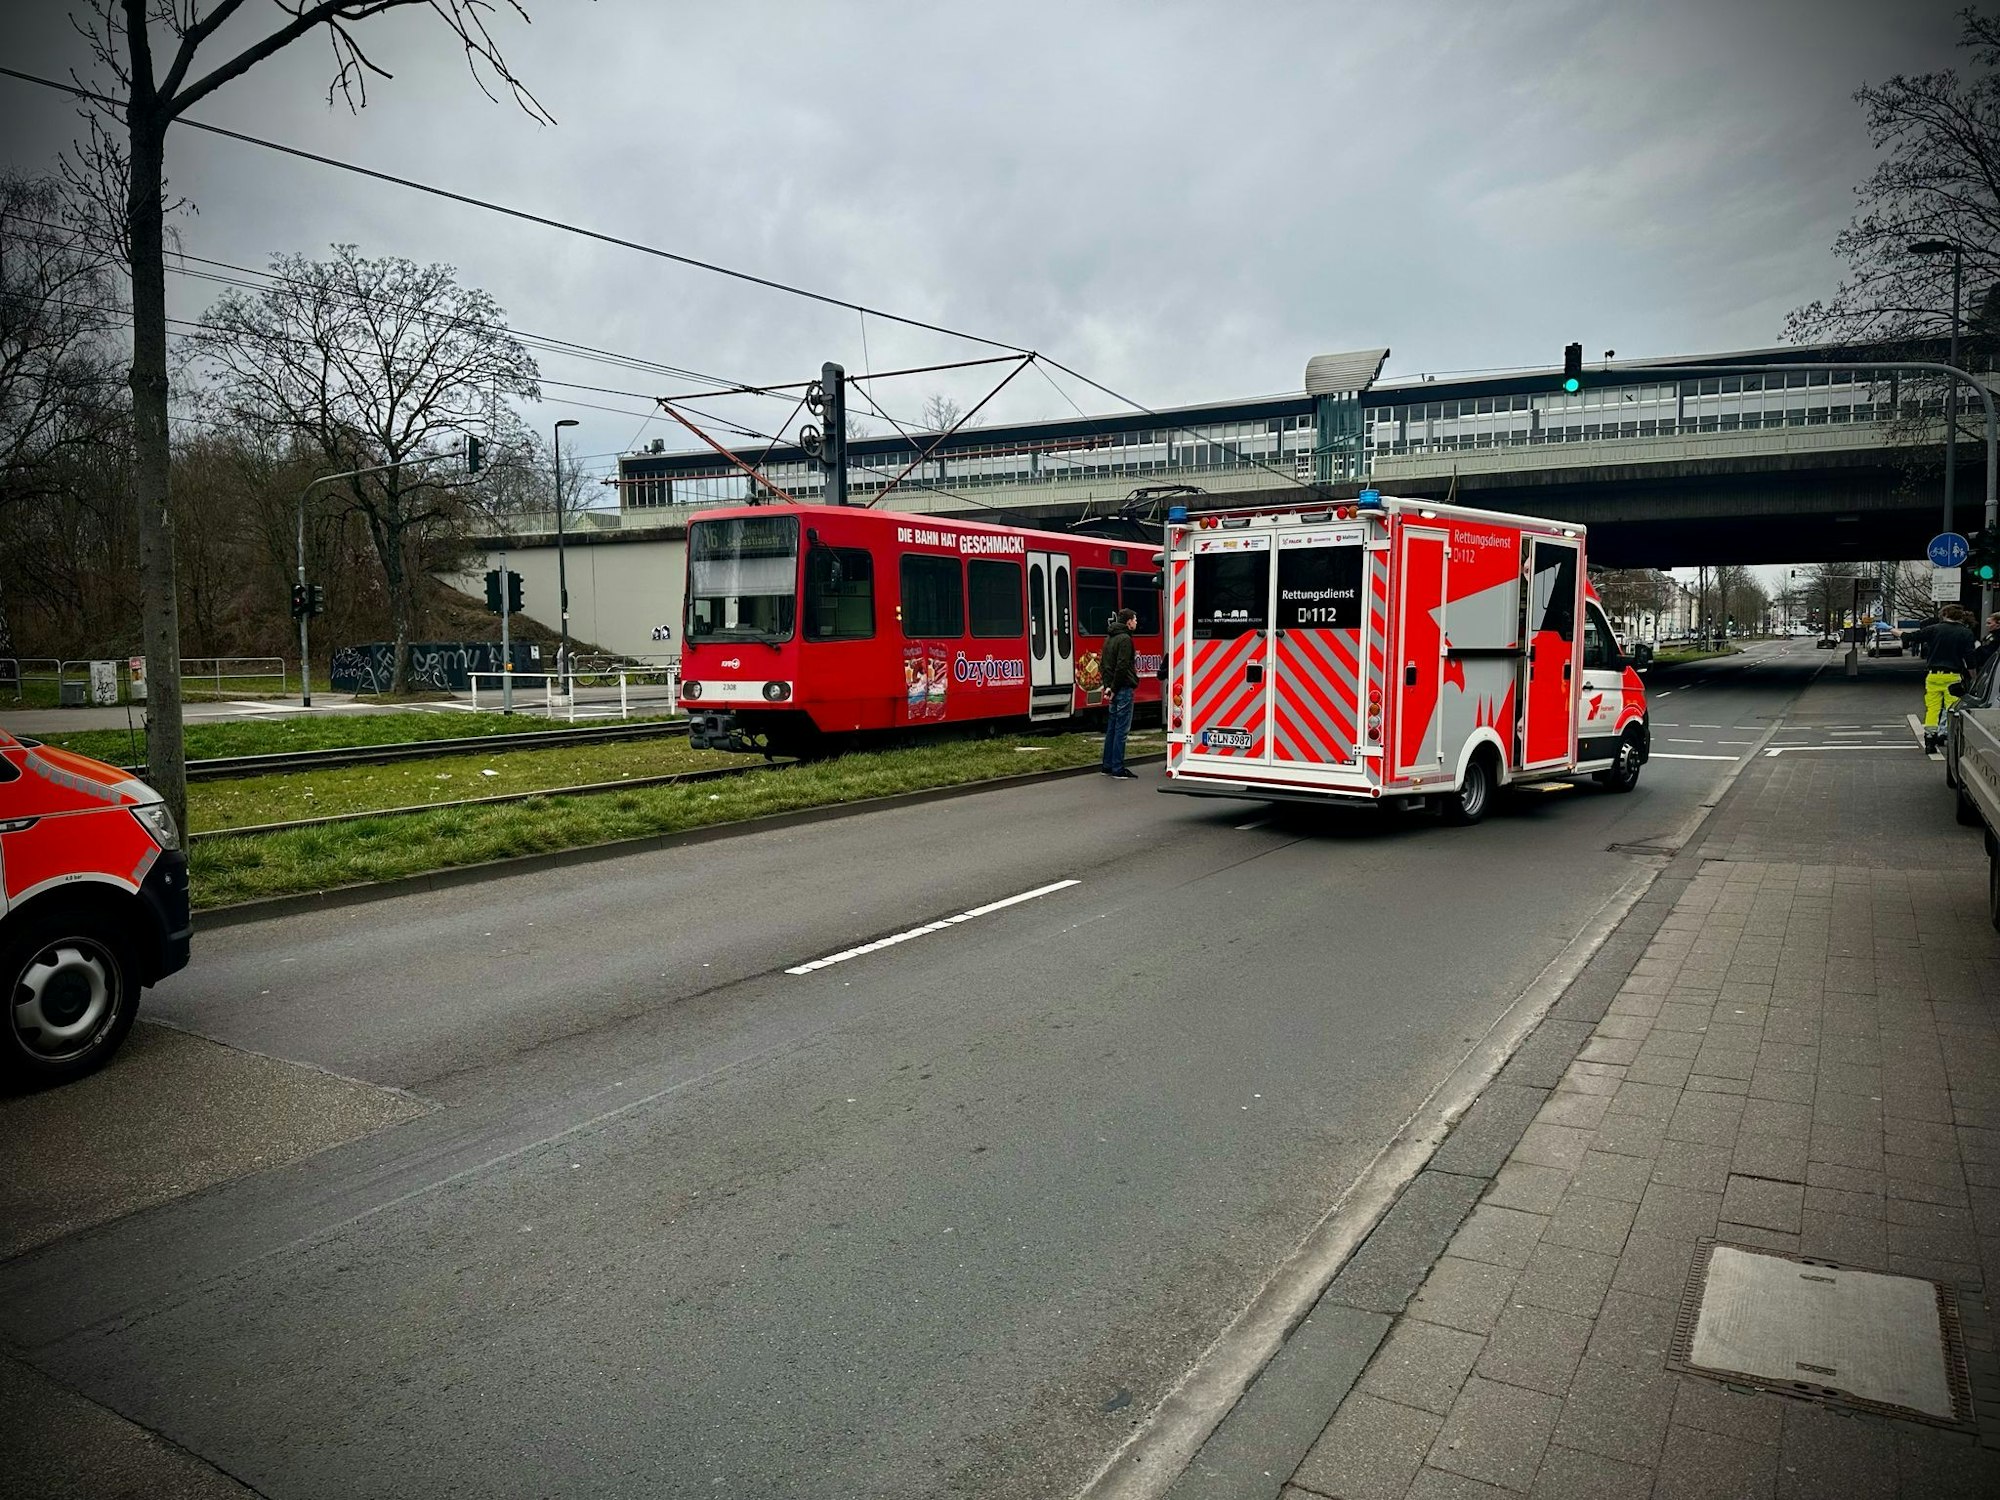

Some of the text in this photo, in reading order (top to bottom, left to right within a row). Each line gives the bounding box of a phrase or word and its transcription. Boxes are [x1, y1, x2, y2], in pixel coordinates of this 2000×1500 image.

[704, 528, 718, 548] 16
[897, 527, 1025, 554] DIE BAHN HAT GESCHMACK!
[1454, 529, 1511, 549] Rettungsdienst
[1462, 549, 1475, 563] 112
[1282, 587, 1355, 602] Rettungsdienst
[1311, 607, 1337, 622] 112
[954, 651, 1025, 687] Özyörem
[1217, 735, 1228, 744] LN
[1229, 735, 1250, 745] 3987
